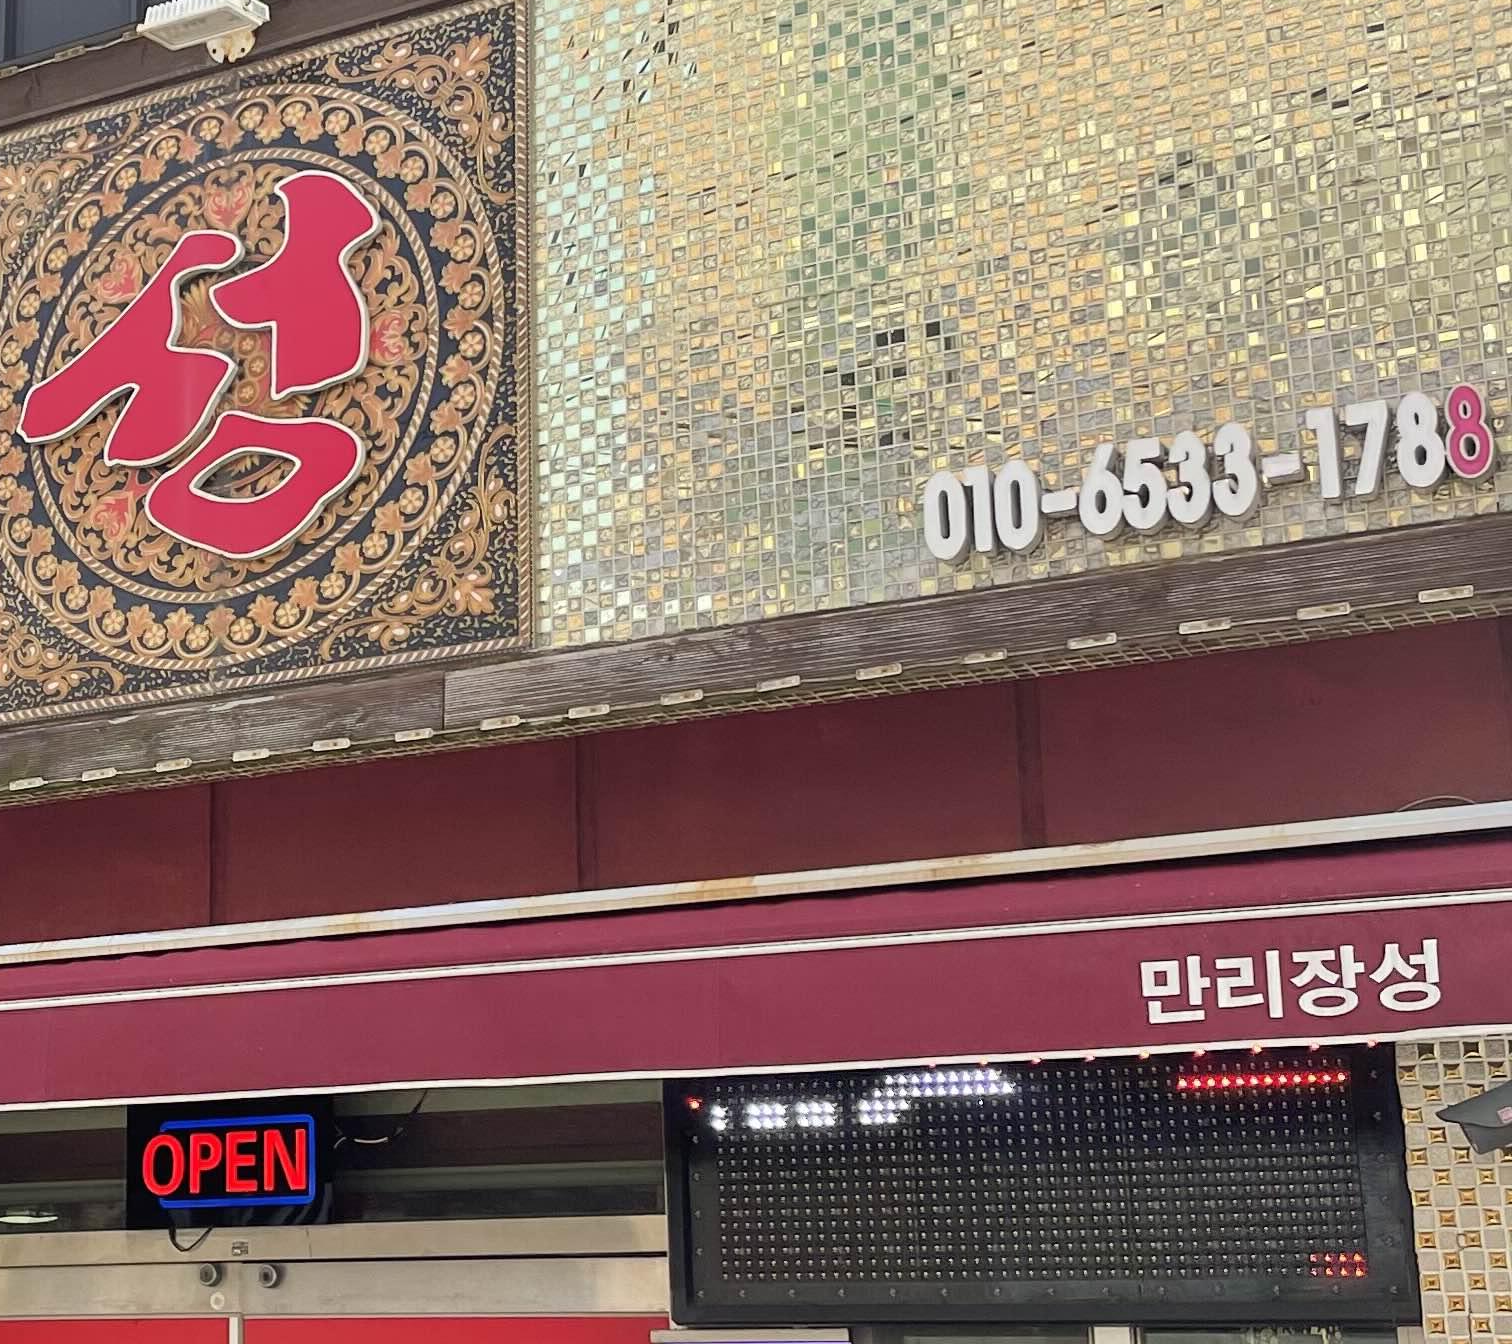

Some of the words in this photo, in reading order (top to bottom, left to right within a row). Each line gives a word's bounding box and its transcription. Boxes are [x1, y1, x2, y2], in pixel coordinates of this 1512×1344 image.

[924, 384, 1494, 561] 010-6533-1788
[1140, 939, 1441, 1024] 만리장성
[142, 1128, 306, 1196] OPEN
